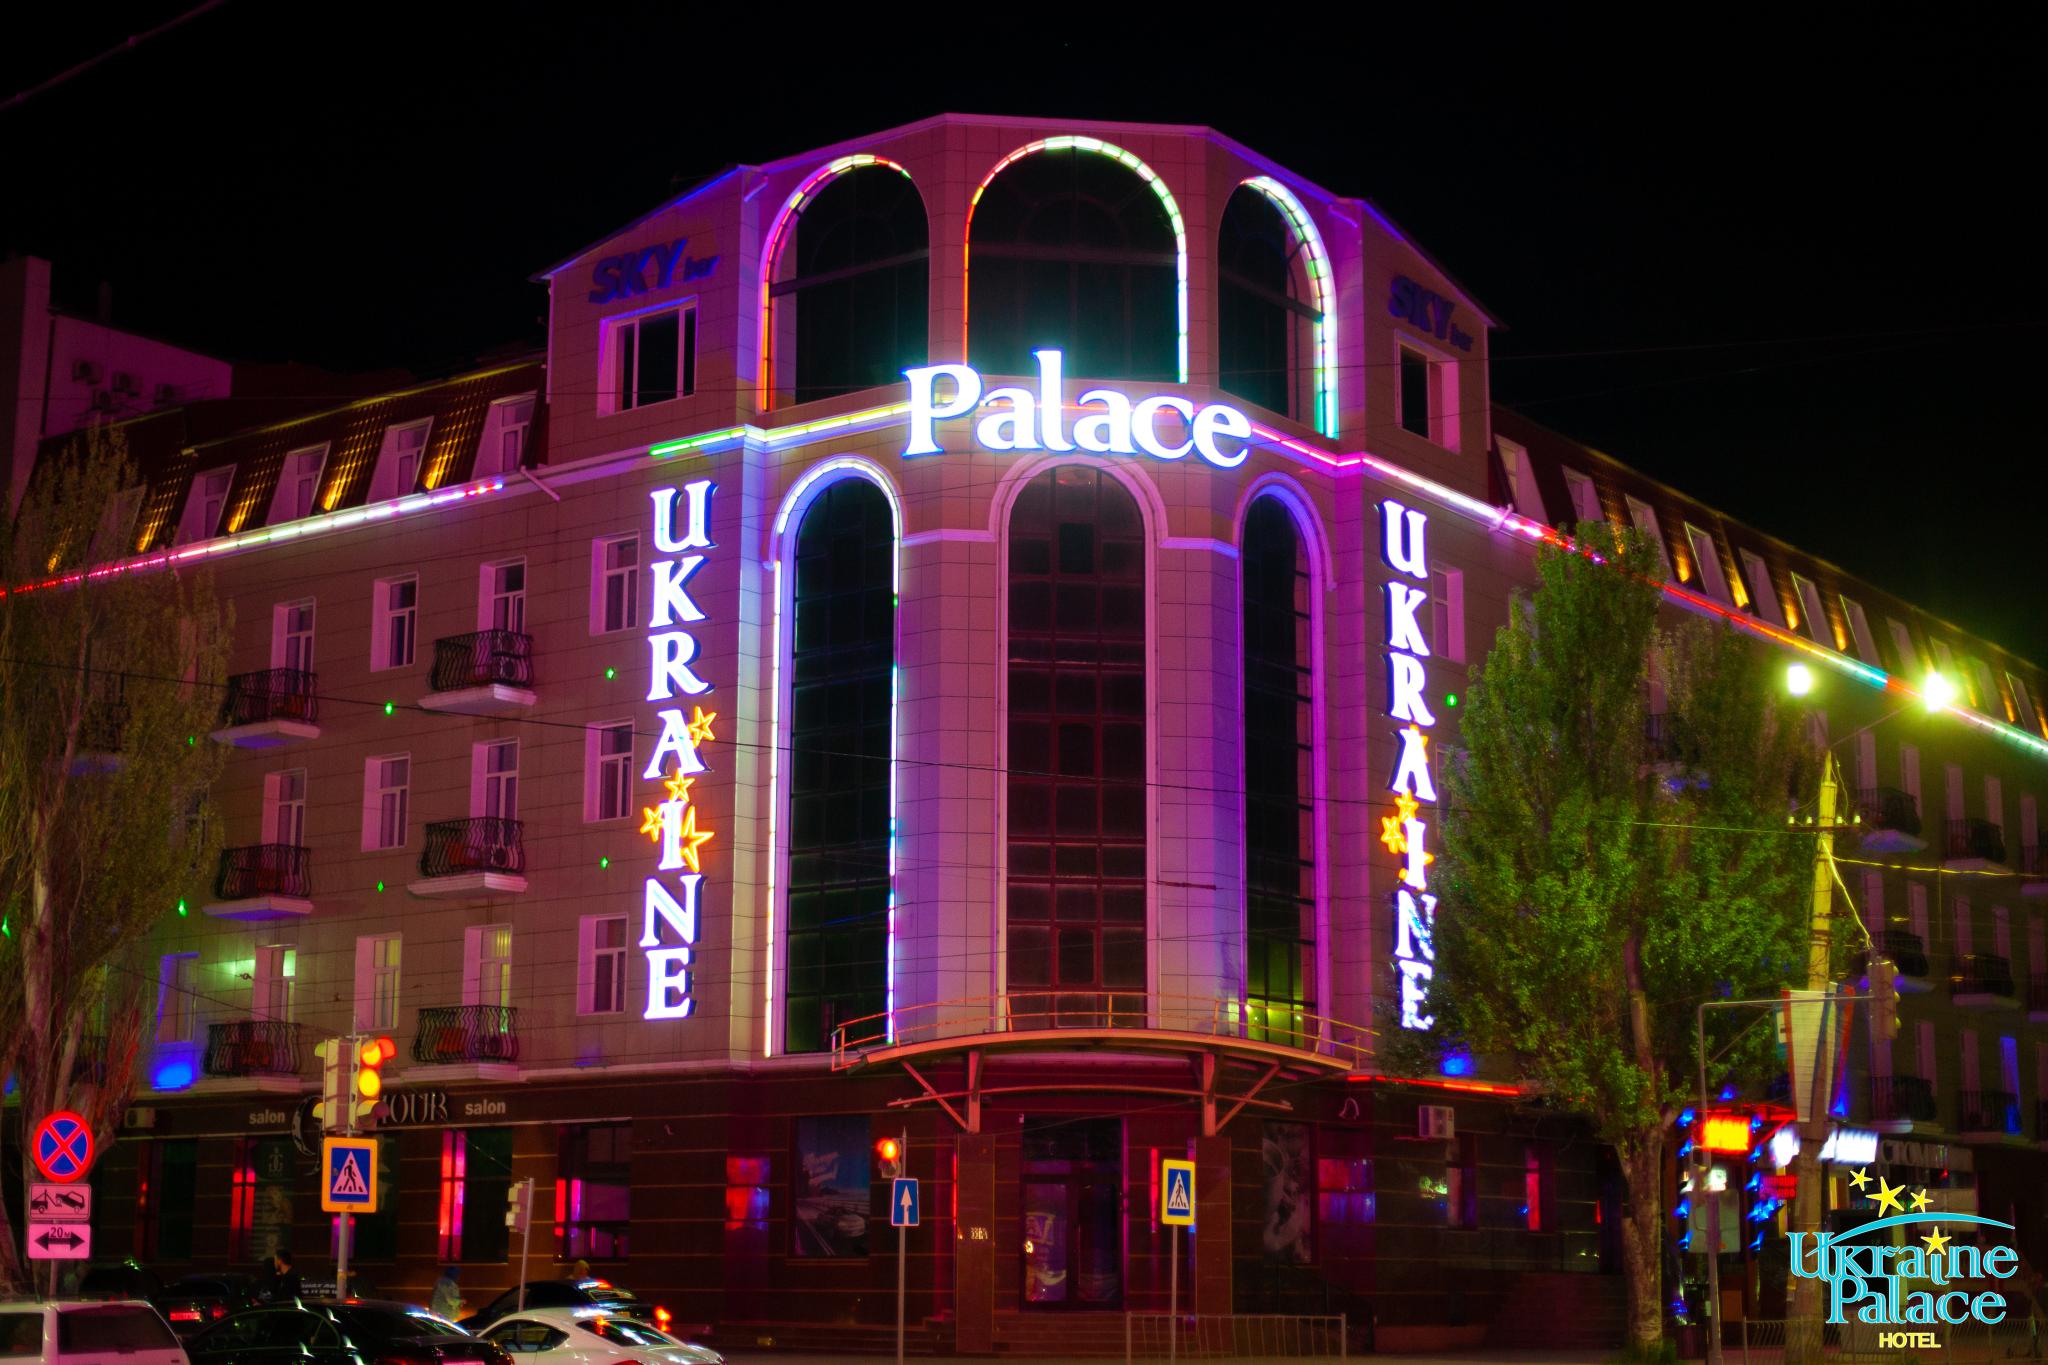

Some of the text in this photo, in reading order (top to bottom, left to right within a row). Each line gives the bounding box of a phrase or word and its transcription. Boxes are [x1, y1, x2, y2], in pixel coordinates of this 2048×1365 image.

[588, 238, 720, 304] SKY bar
[1388, 275, 1455, 340] SKY
[901, 346, 1252, 469] Palace
[640, 479, 714, 1021] UKRAINE
[1380, 499, 1437, 1031] UKRAINE
[248, 1108, 286, 1126] salon
[464, 1098, 507, 1117] salon
